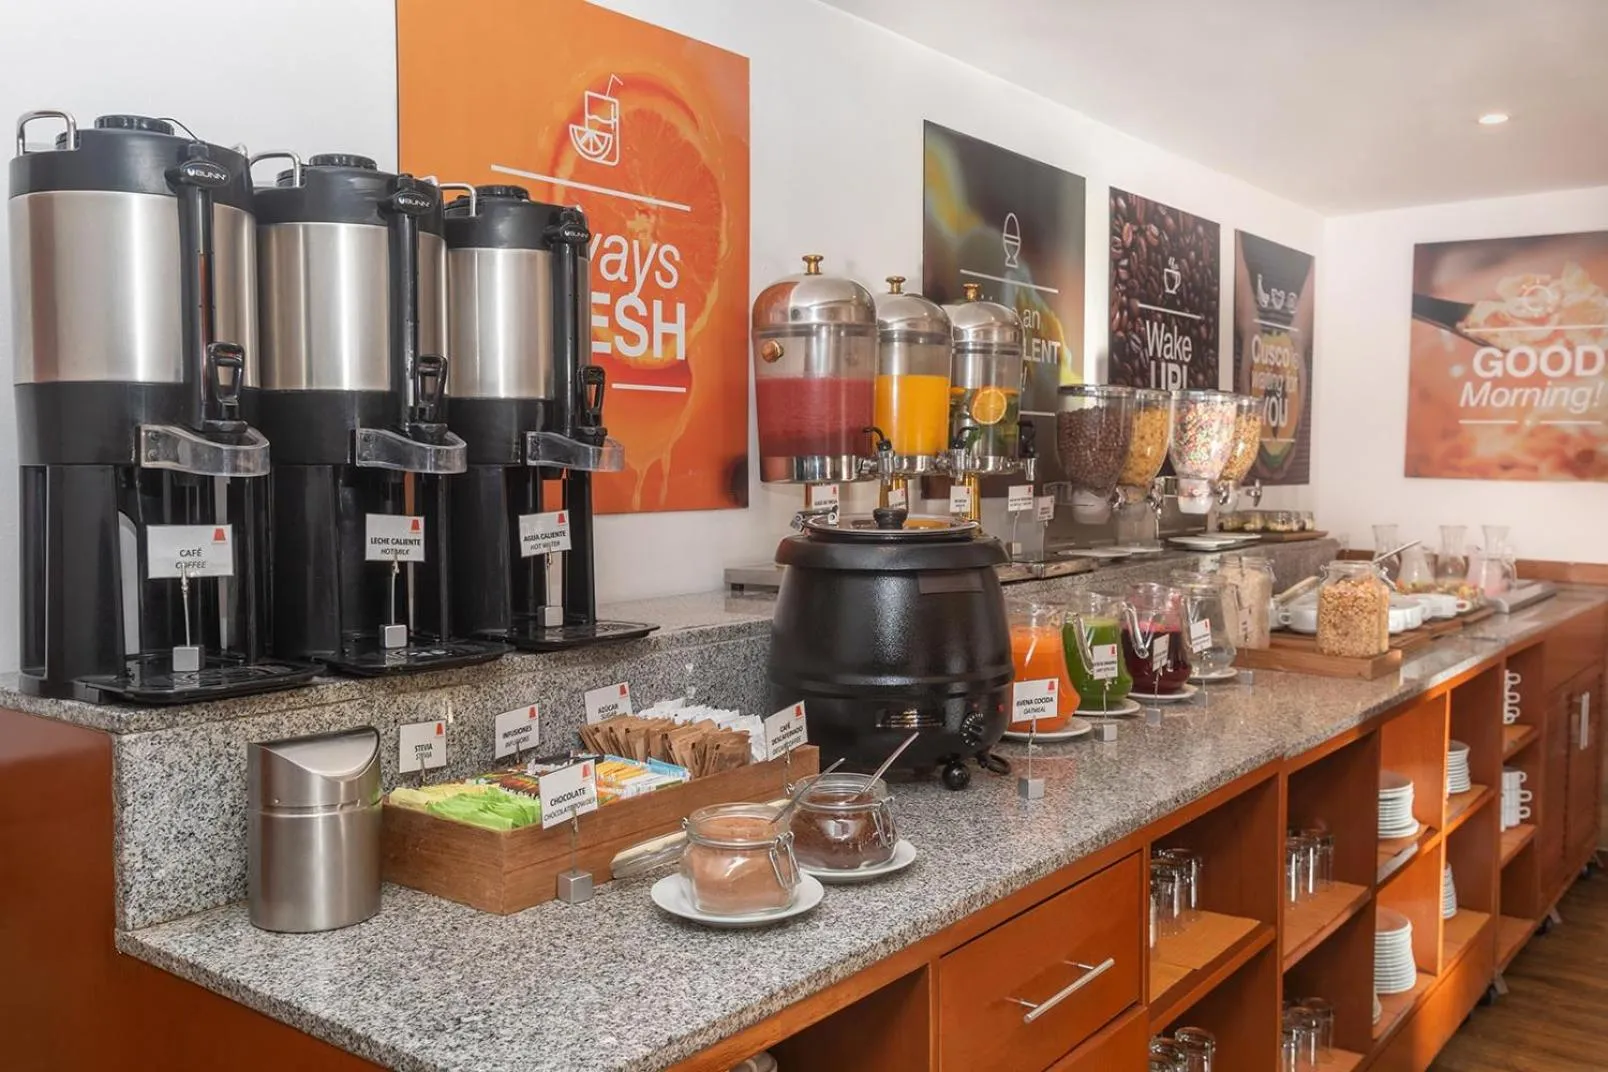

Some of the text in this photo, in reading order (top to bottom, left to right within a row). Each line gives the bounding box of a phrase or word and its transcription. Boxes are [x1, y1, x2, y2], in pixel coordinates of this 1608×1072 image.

[194, 169, 226, 180] BUNN
[404, 198, 430, 208] BUNN
[1145, 319, 1193, 363] Wake
[1251, 334, 1290, 368] Cusco
[1472, 345, 1606, 379] GOOD
[1459, 380, 1605, 414] Morning!
[370, 537, 421, 546] LECHE CALIENTE
[523, 530, 567, 542] AGUA CALIENTE
[179, 547, 203, 558] CAFÉ
[414, 743, 433, 752] STEVIA
[549, 787, 587, 808] CHOCOLATE
